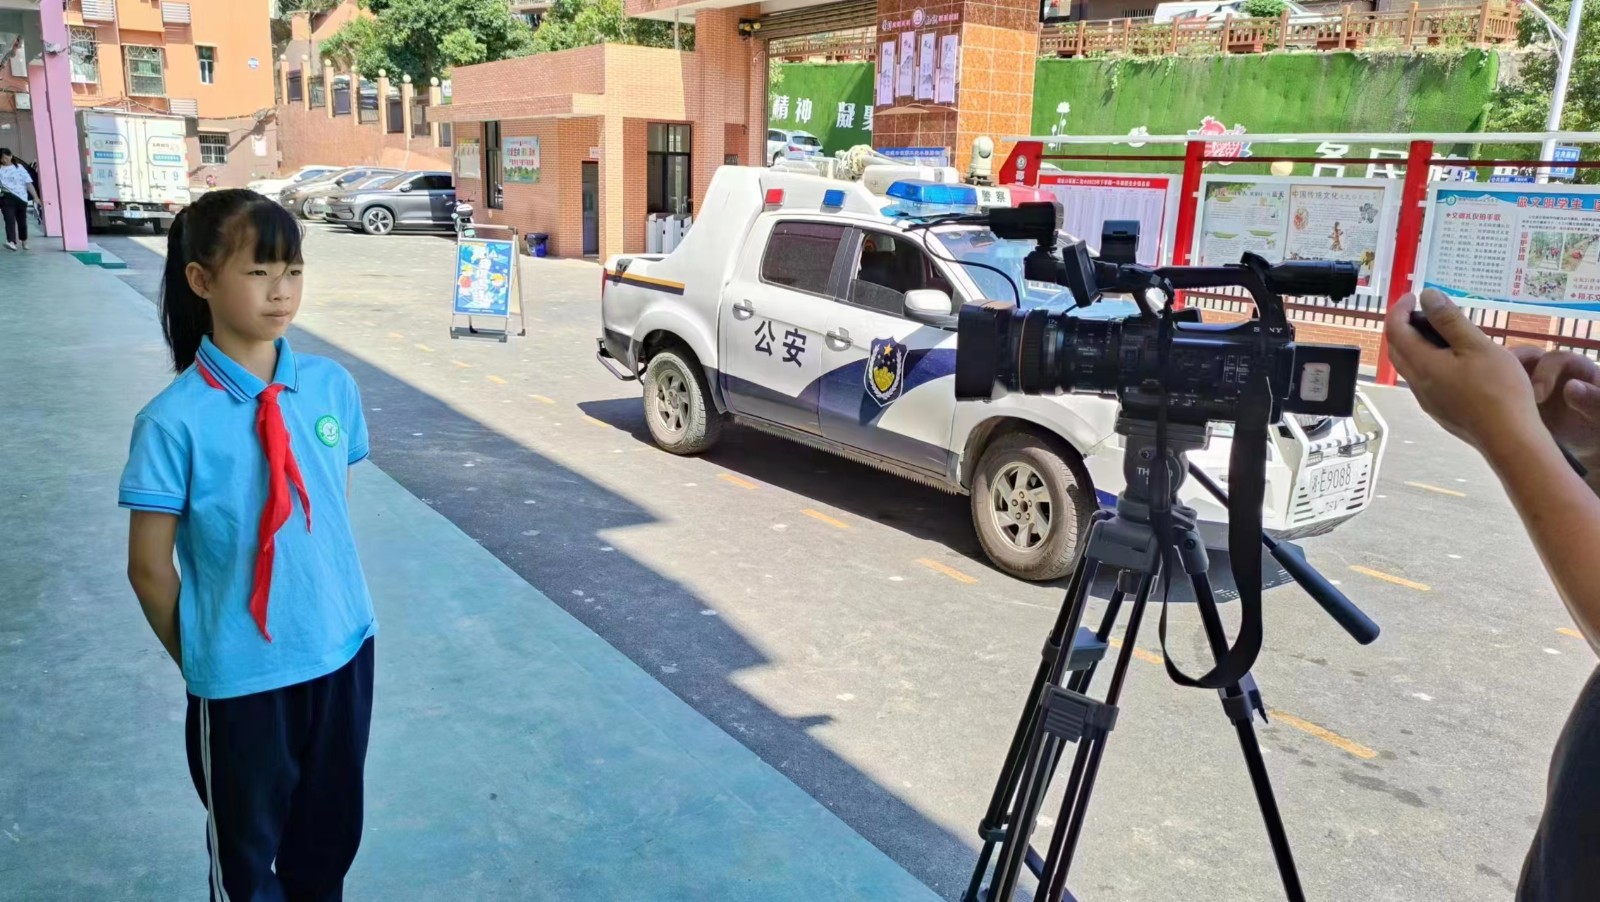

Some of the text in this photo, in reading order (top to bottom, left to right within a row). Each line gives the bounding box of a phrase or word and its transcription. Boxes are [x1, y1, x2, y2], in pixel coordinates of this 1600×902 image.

[981, 190, 1007, 203] 警察
[1517, 196, 1584, 209] 做文明学生
[1253, 326, 1284, 334] SNY
[754, 320, 807, 368] 公安
